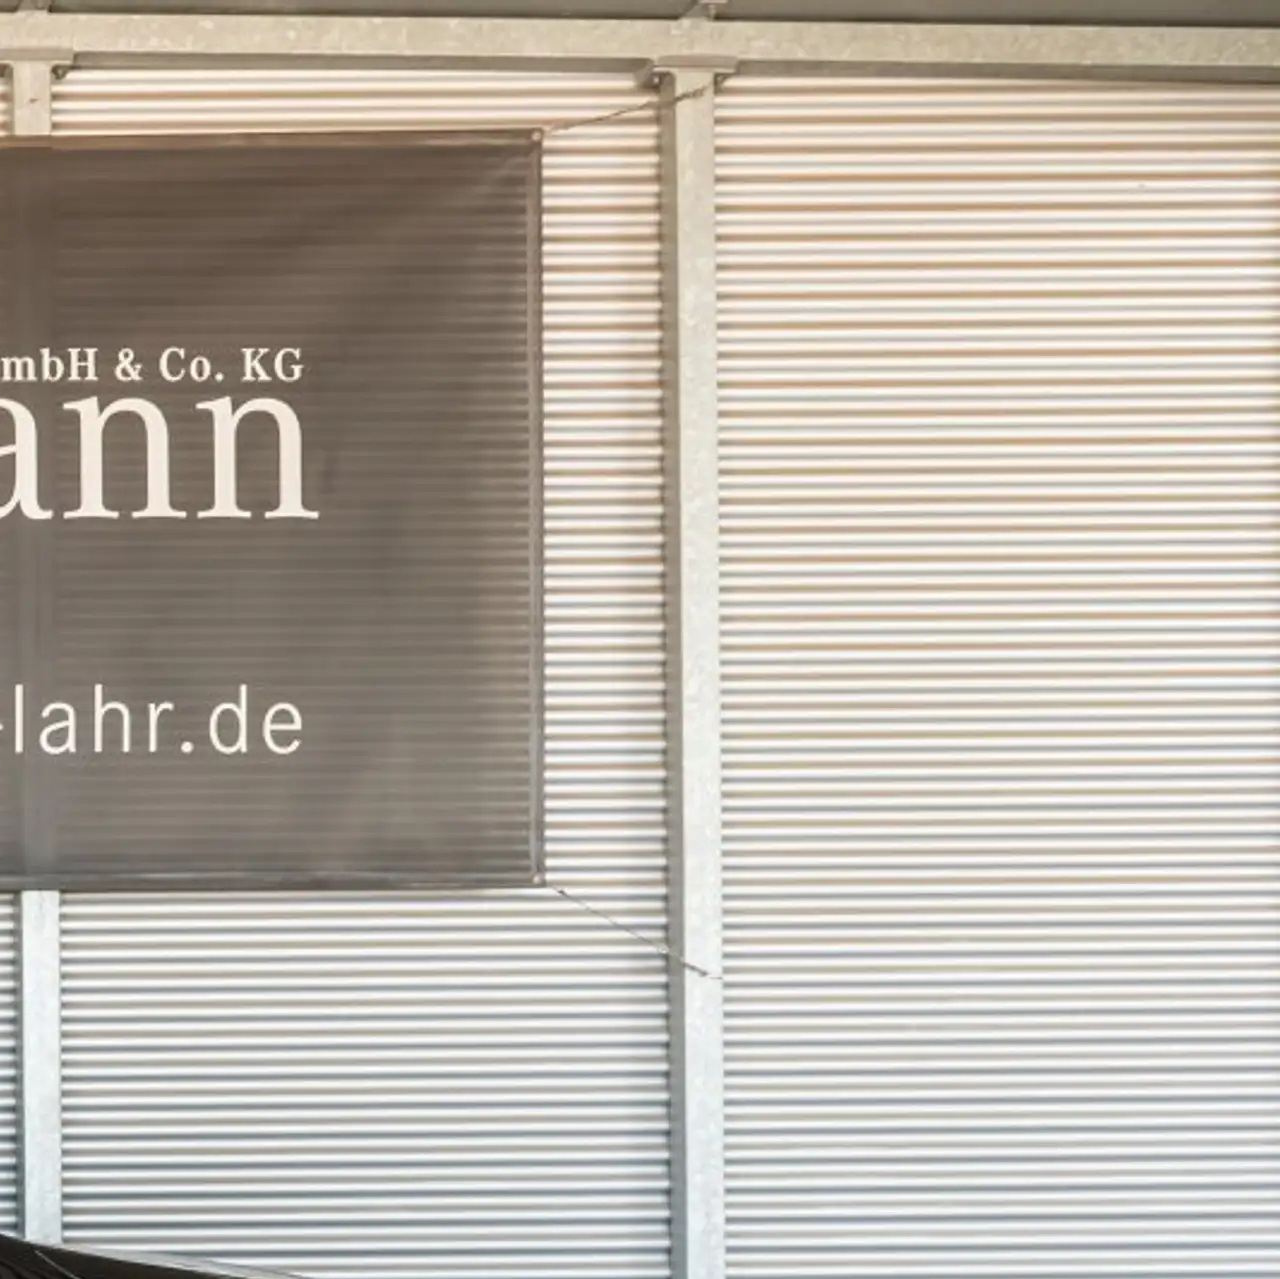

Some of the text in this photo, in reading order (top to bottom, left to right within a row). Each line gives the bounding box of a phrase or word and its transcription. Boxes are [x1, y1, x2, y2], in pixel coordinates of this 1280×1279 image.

[114, 347, 143, 383] &
[159, 347, 224, 383] Co.
[241, 347, 303, 382] KG
